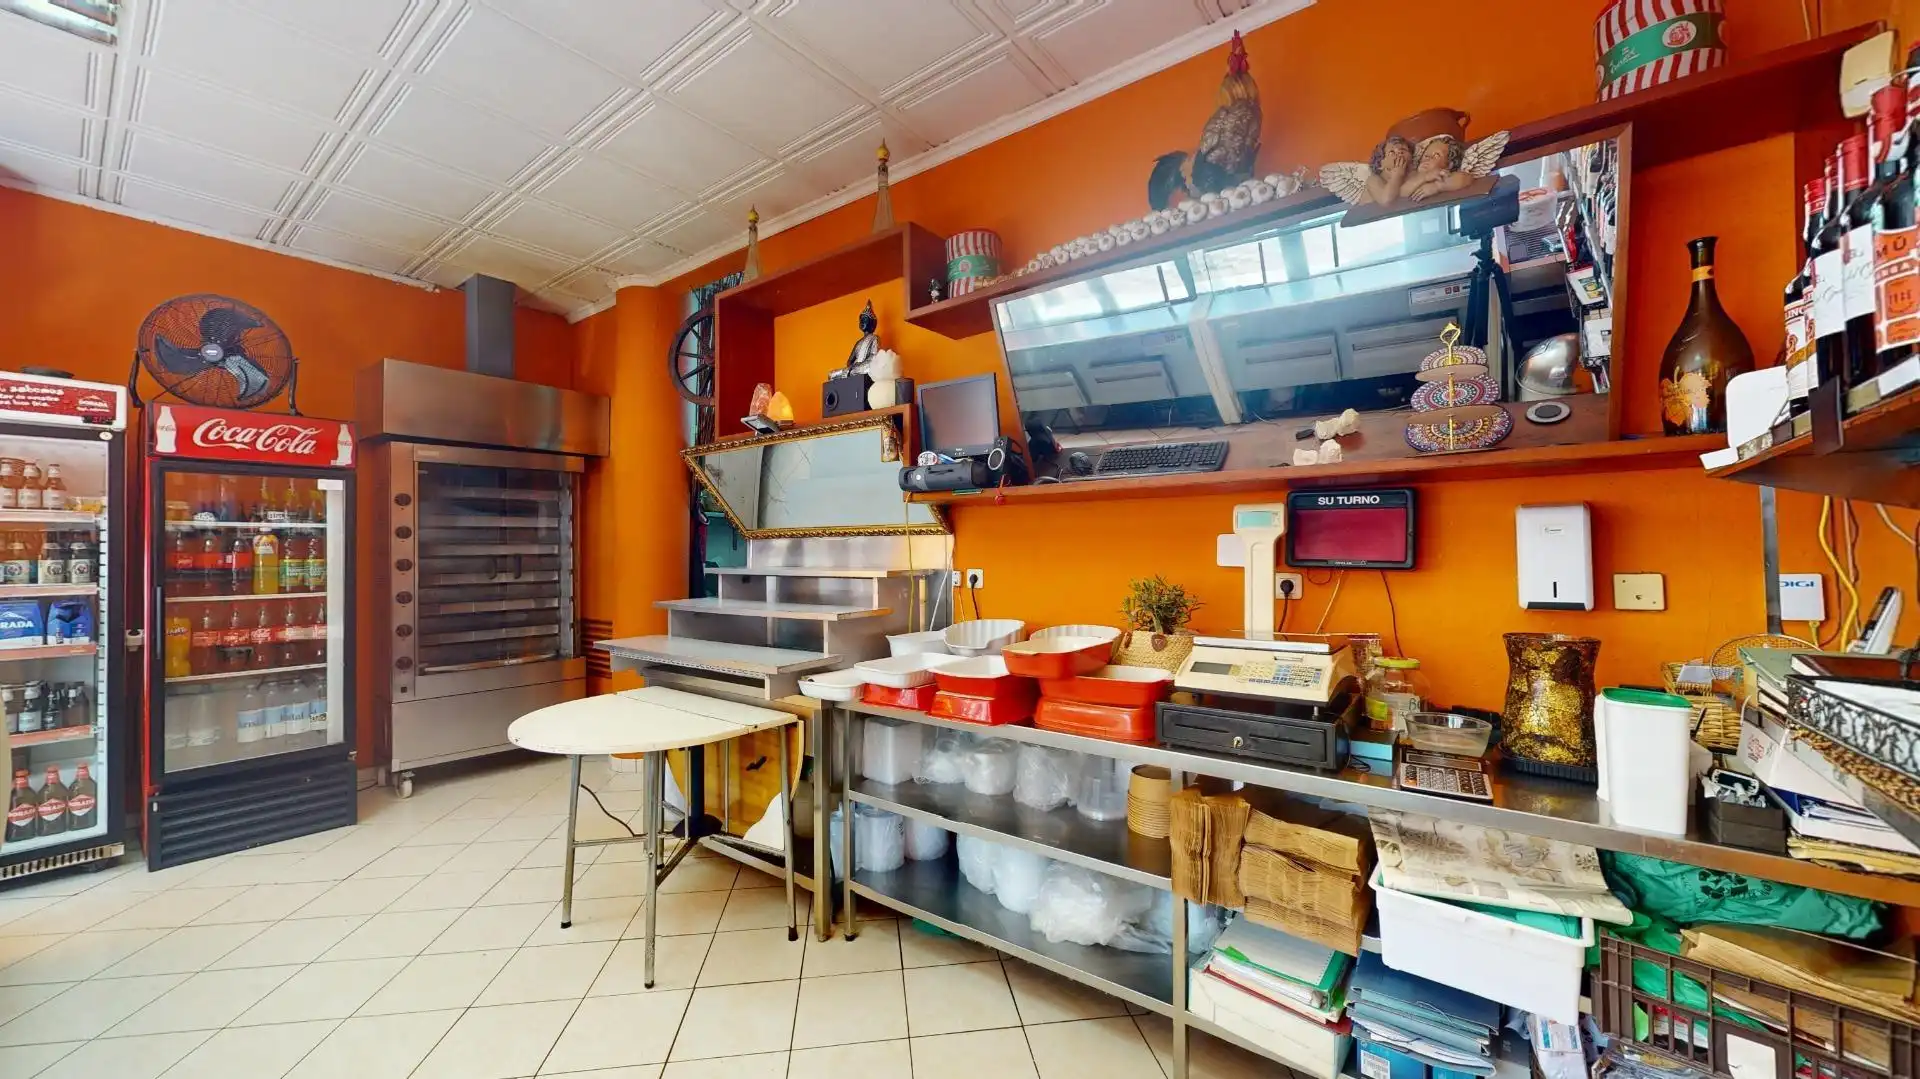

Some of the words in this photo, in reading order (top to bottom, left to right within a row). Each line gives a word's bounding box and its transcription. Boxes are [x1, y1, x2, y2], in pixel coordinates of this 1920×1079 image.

[192, 418, 324, 454] Coca-Cola
[1318, 496, 1334, 505] SU
[1336, 495, 1380, 505] TURNO
